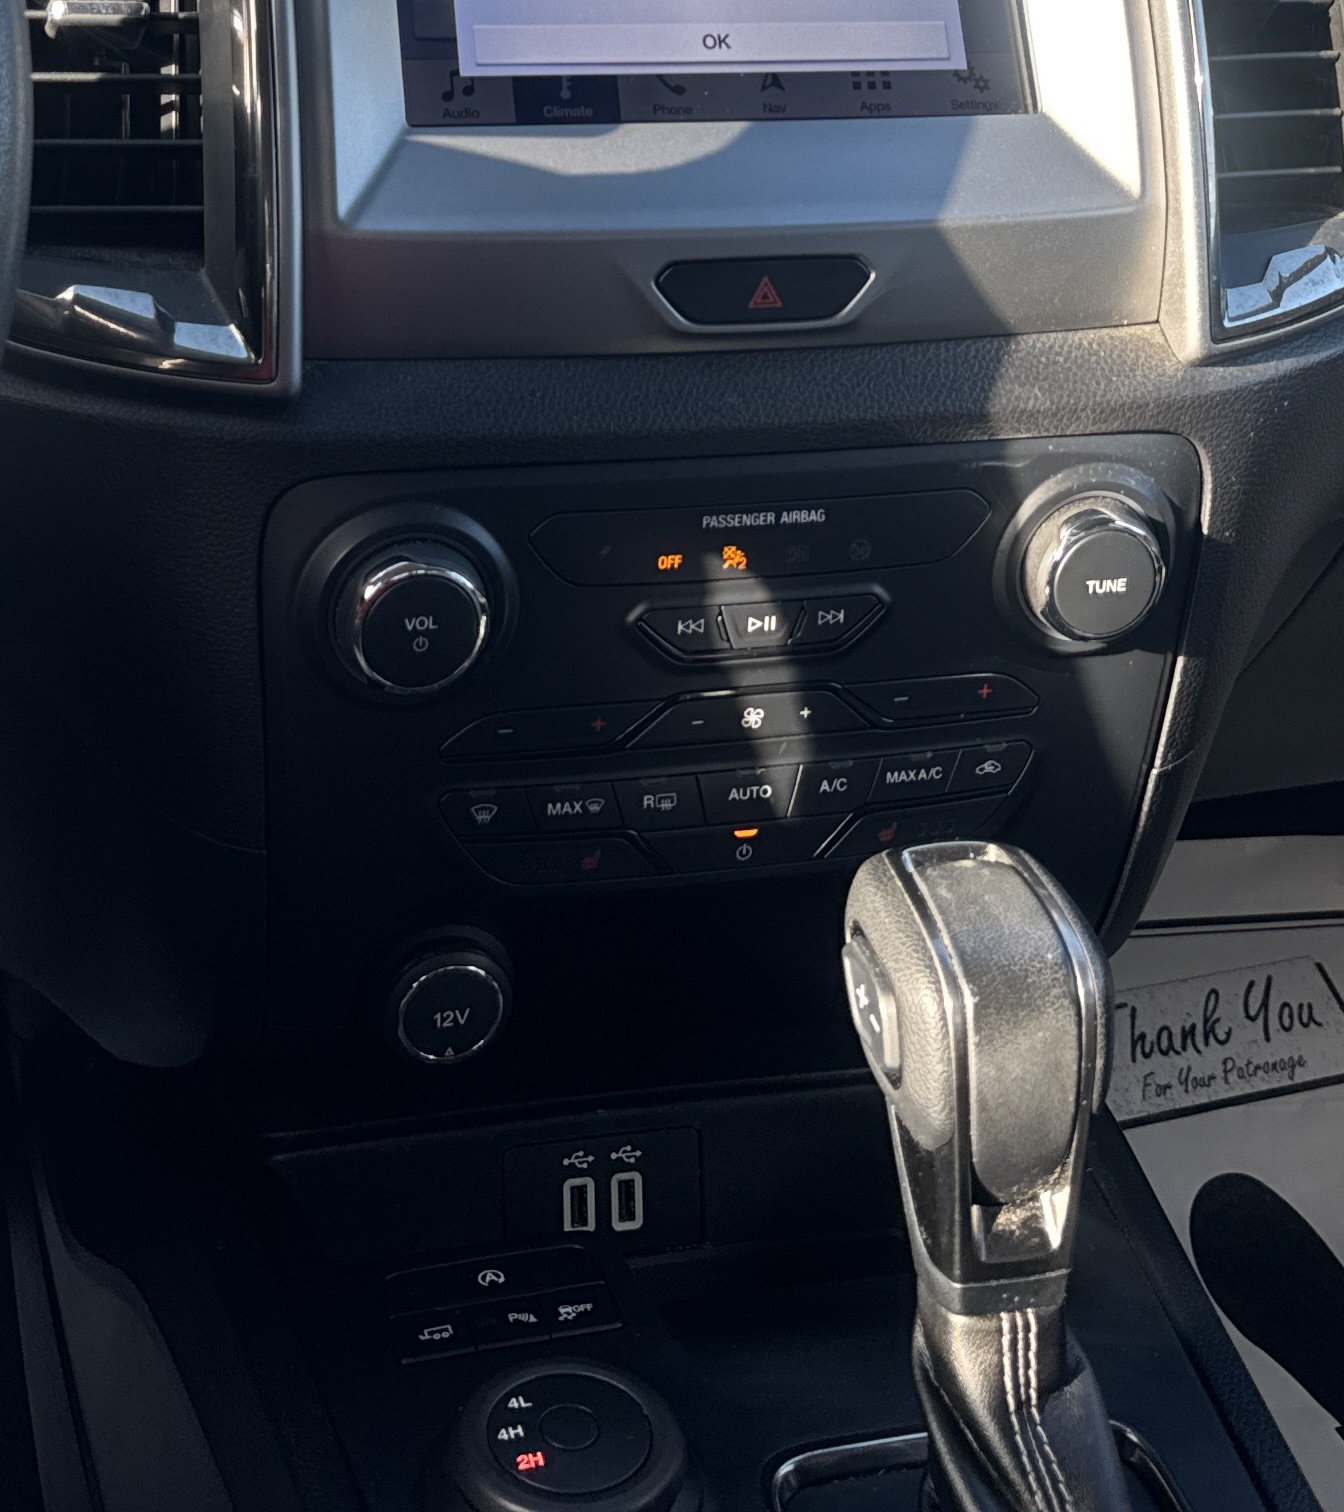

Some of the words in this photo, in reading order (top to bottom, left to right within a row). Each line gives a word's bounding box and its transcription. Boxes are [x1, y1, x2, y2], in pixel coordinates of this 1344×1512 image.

[702, 32, 731, 51] OK
[442, 105, 480, 121] Audio
[542, 103, 594, 119] Climate
[652, 101, 693, 117] Phone
[762, 100, 788, 115] Nav
[859, 99, 892, 116] Apps
[702, 512, 776, 529] PASSENGER
[780, 508, 826, 525] AIRBAG
[657, 554, 683, 571] OFF
[1086, 577, 1127, 595] TUNE
[404, 615, 439, 631] VOL
[819, 776, 848, 794] A/C
[885, 768, 917, 785] MAX
[728, 784, 773, 801] AUTO
[547, 800, 584, 816] MAX
[642, 794, 655, 809] R
[432, 1008, 472, 1029] 12V
[1114, 987, 1233, 1065] hank
[1242, 973, 1324, 1043] You
[1141, 1071, 1173, 1101] For
[1177, 1065, 1217, 1095] Your
[1221, 1053, 1307, 1085] Patronage
[572, 1302, 593, 1314] OFF
[506, 1395, 534, 1410] 4L
[496, 1424, 525, 1442] 4H
[515, 1450, 546, 1471] 2H
